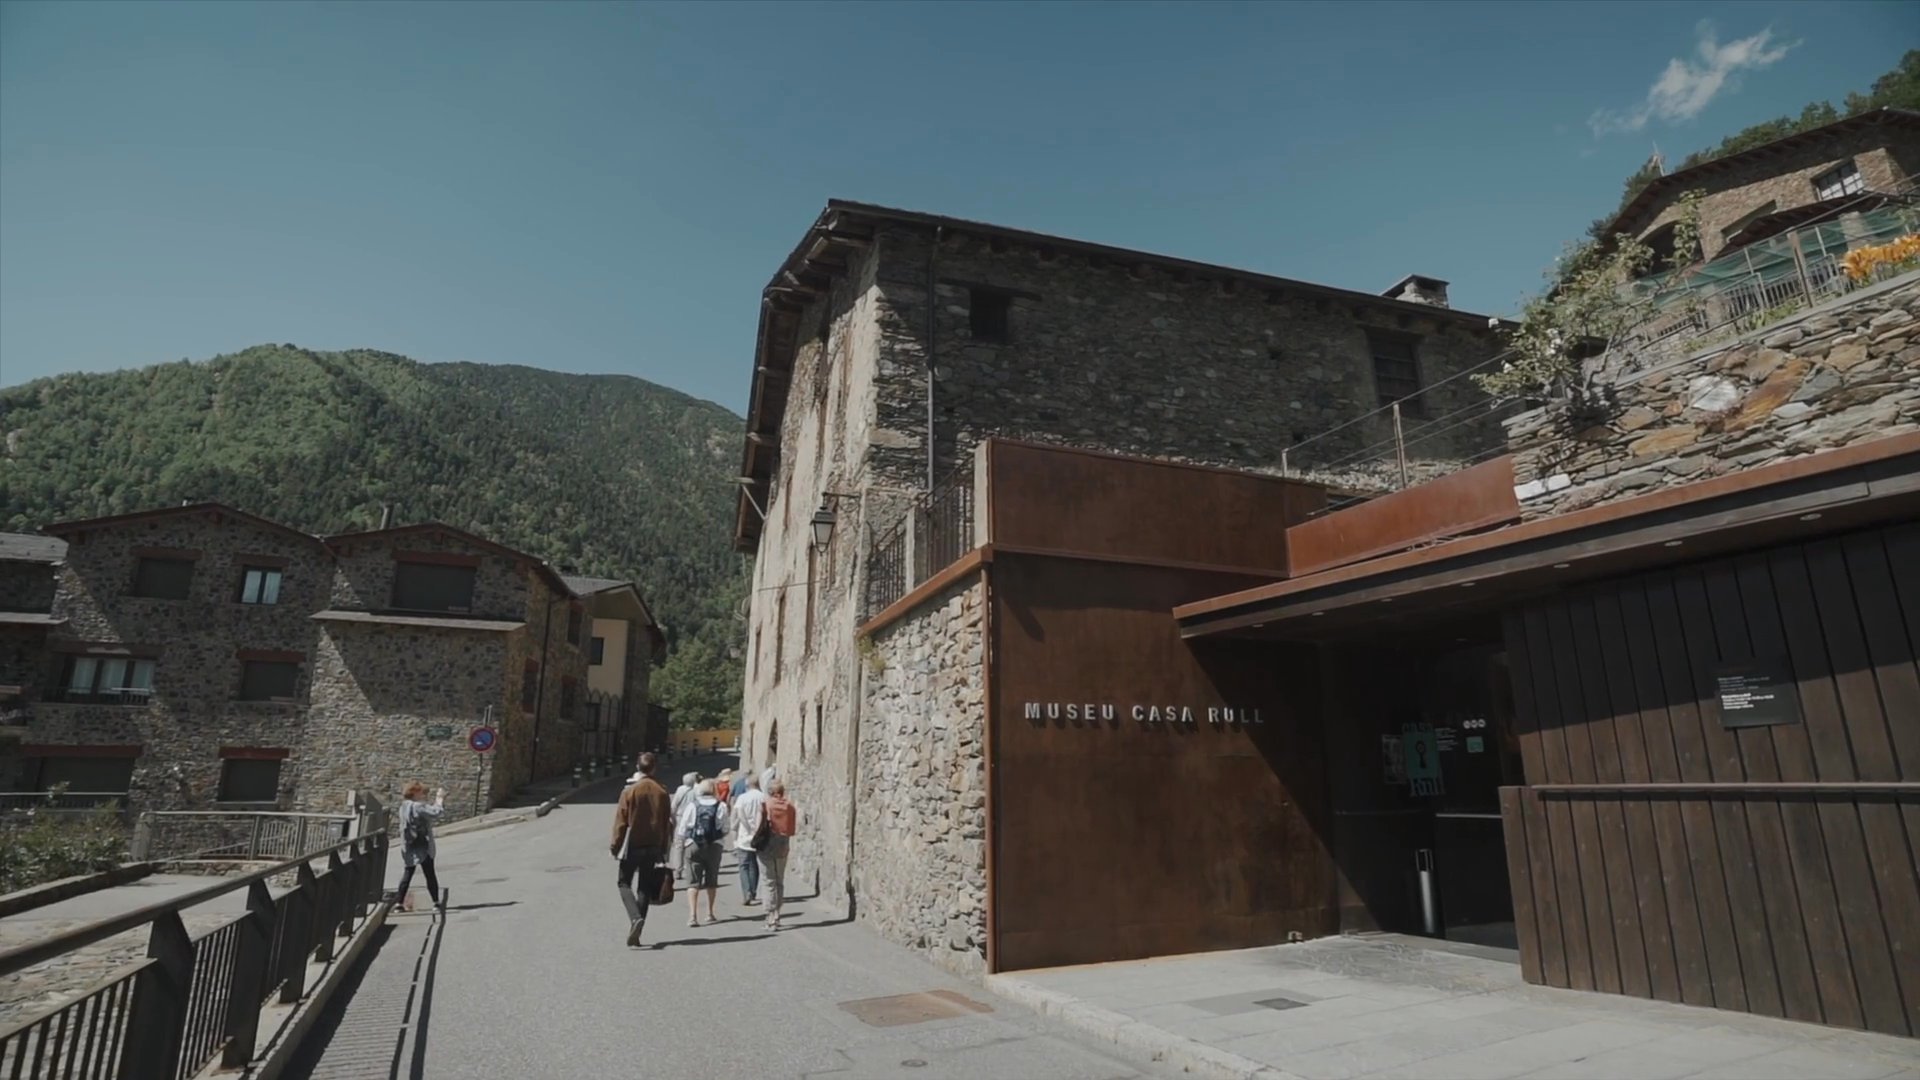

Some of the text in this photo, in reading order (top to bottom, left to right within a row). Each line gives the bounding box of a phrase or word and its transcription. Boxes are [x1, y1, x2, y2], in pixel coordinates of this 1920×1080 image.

[1024, 702, 1264, 724] MUSEU CASA RULL
